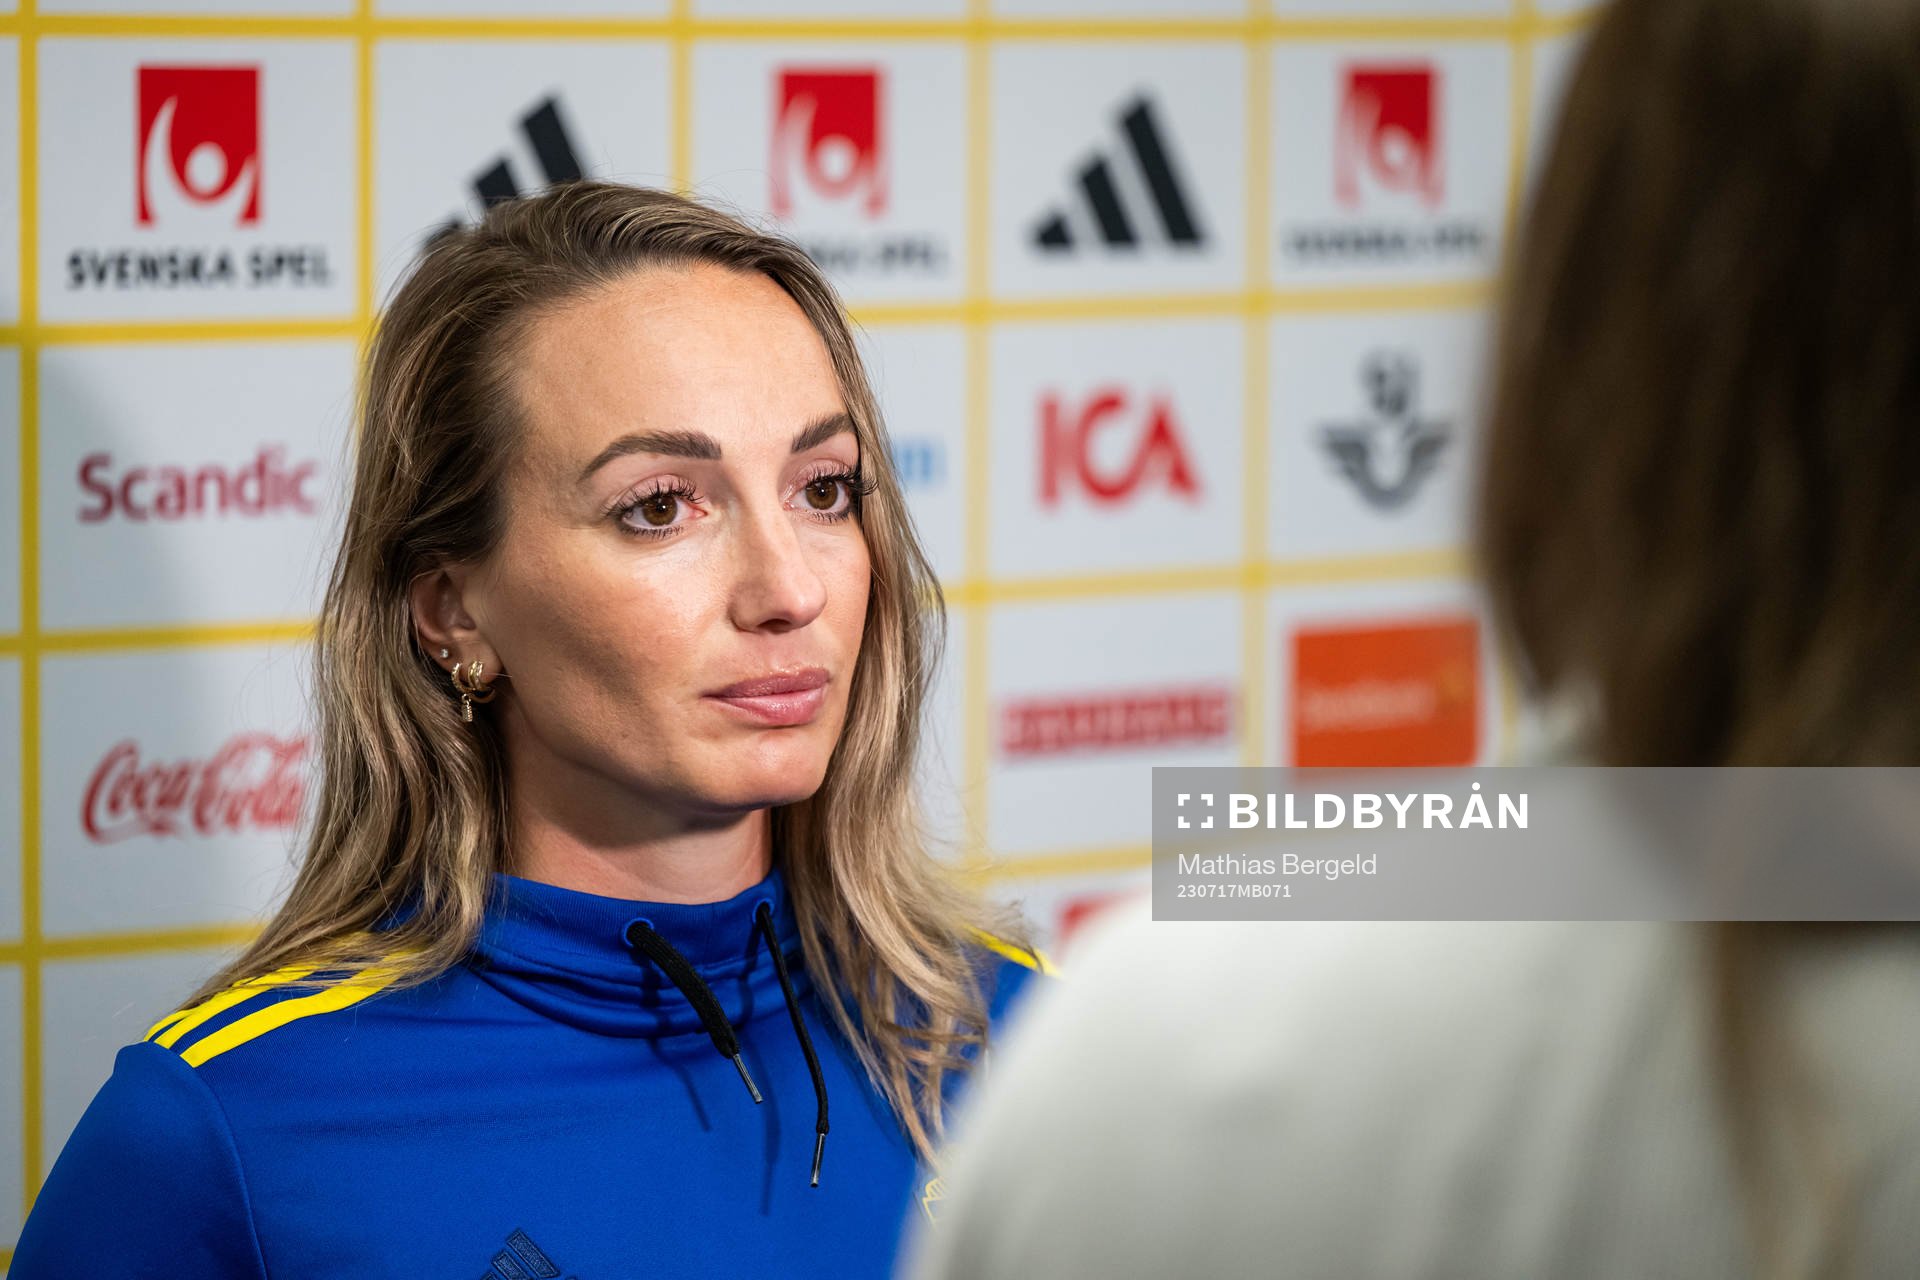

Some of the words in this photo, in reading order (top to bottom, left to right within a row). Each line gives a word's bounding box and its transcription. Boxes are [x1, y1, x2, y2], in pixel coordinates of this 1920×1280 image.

[66, 248, 236, 290] SVENSKA
[248, 246, 333, 288] SPEL
[78, 446, 317, 523] Scandic
[1038, 388, 1202, 508] ICA
